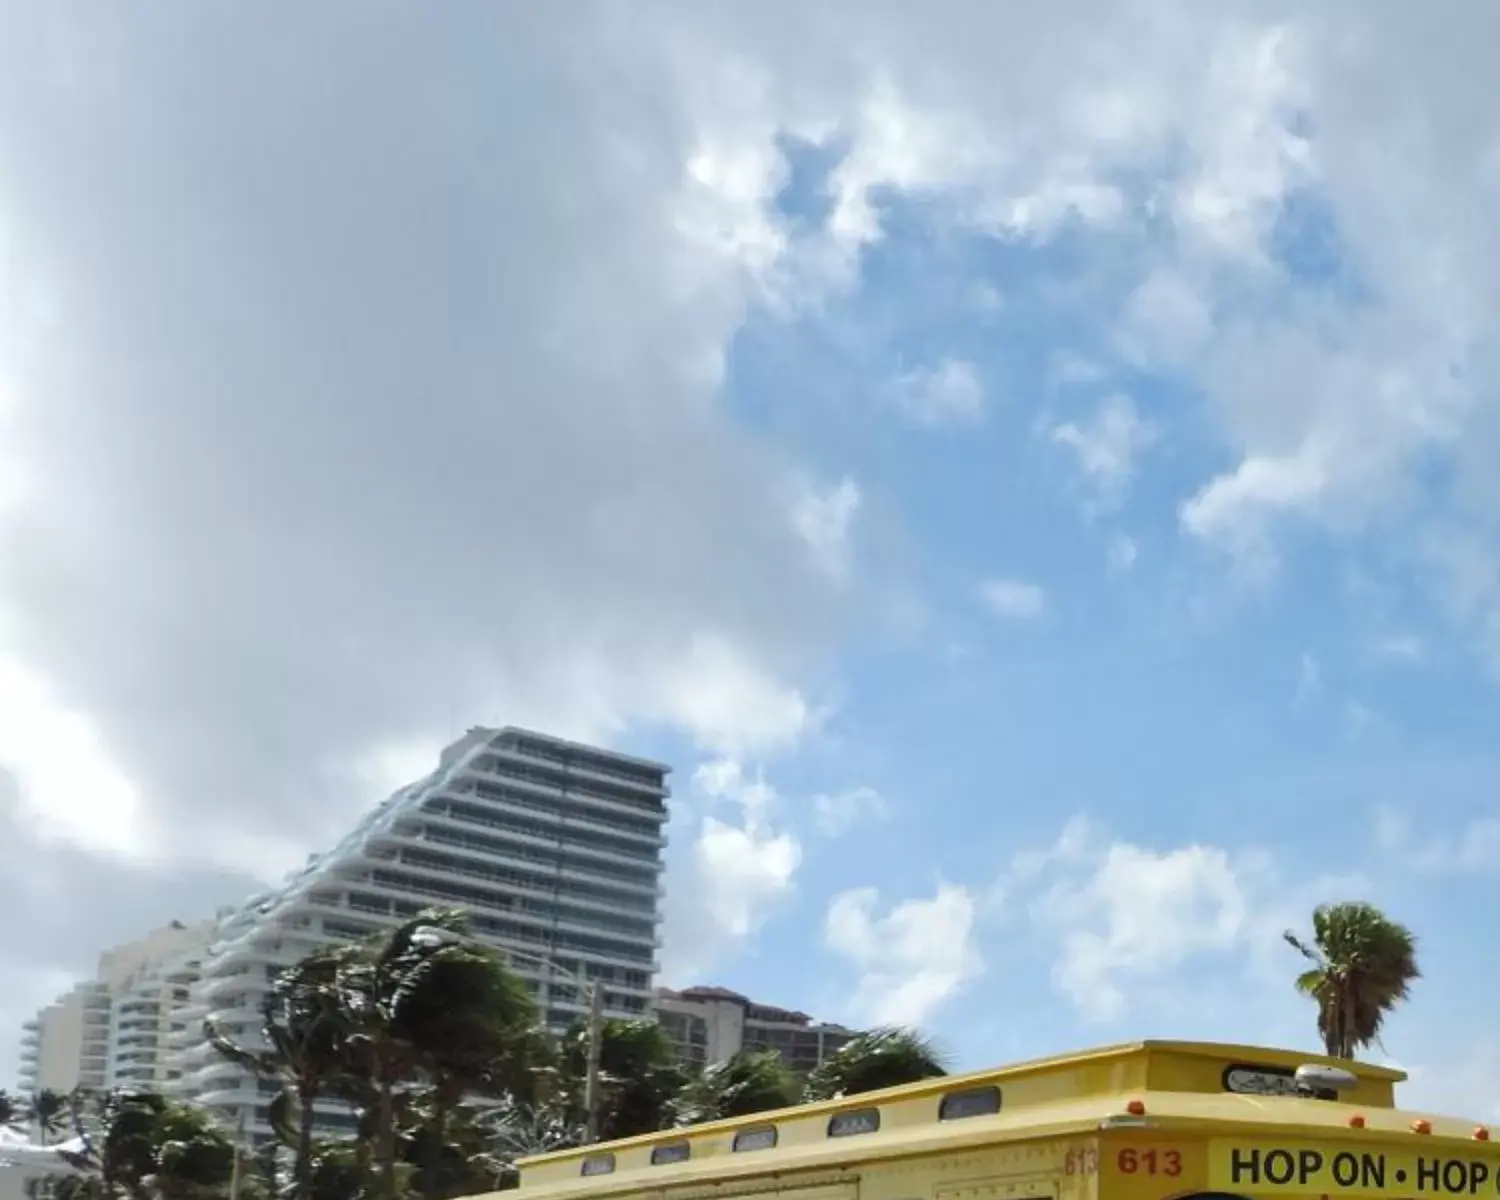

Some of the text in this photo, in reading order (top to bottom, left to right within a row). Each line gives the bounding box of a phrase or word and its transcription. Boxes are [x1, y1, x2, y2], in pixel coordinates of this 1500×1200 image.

[1117, 1148, 1183, 1177] 613
[1230, 1148, 1323, 1185] HOP
[1331, 1152, 1385, 1189] ON
[1417, 1157, 1489, 1194] HOP
